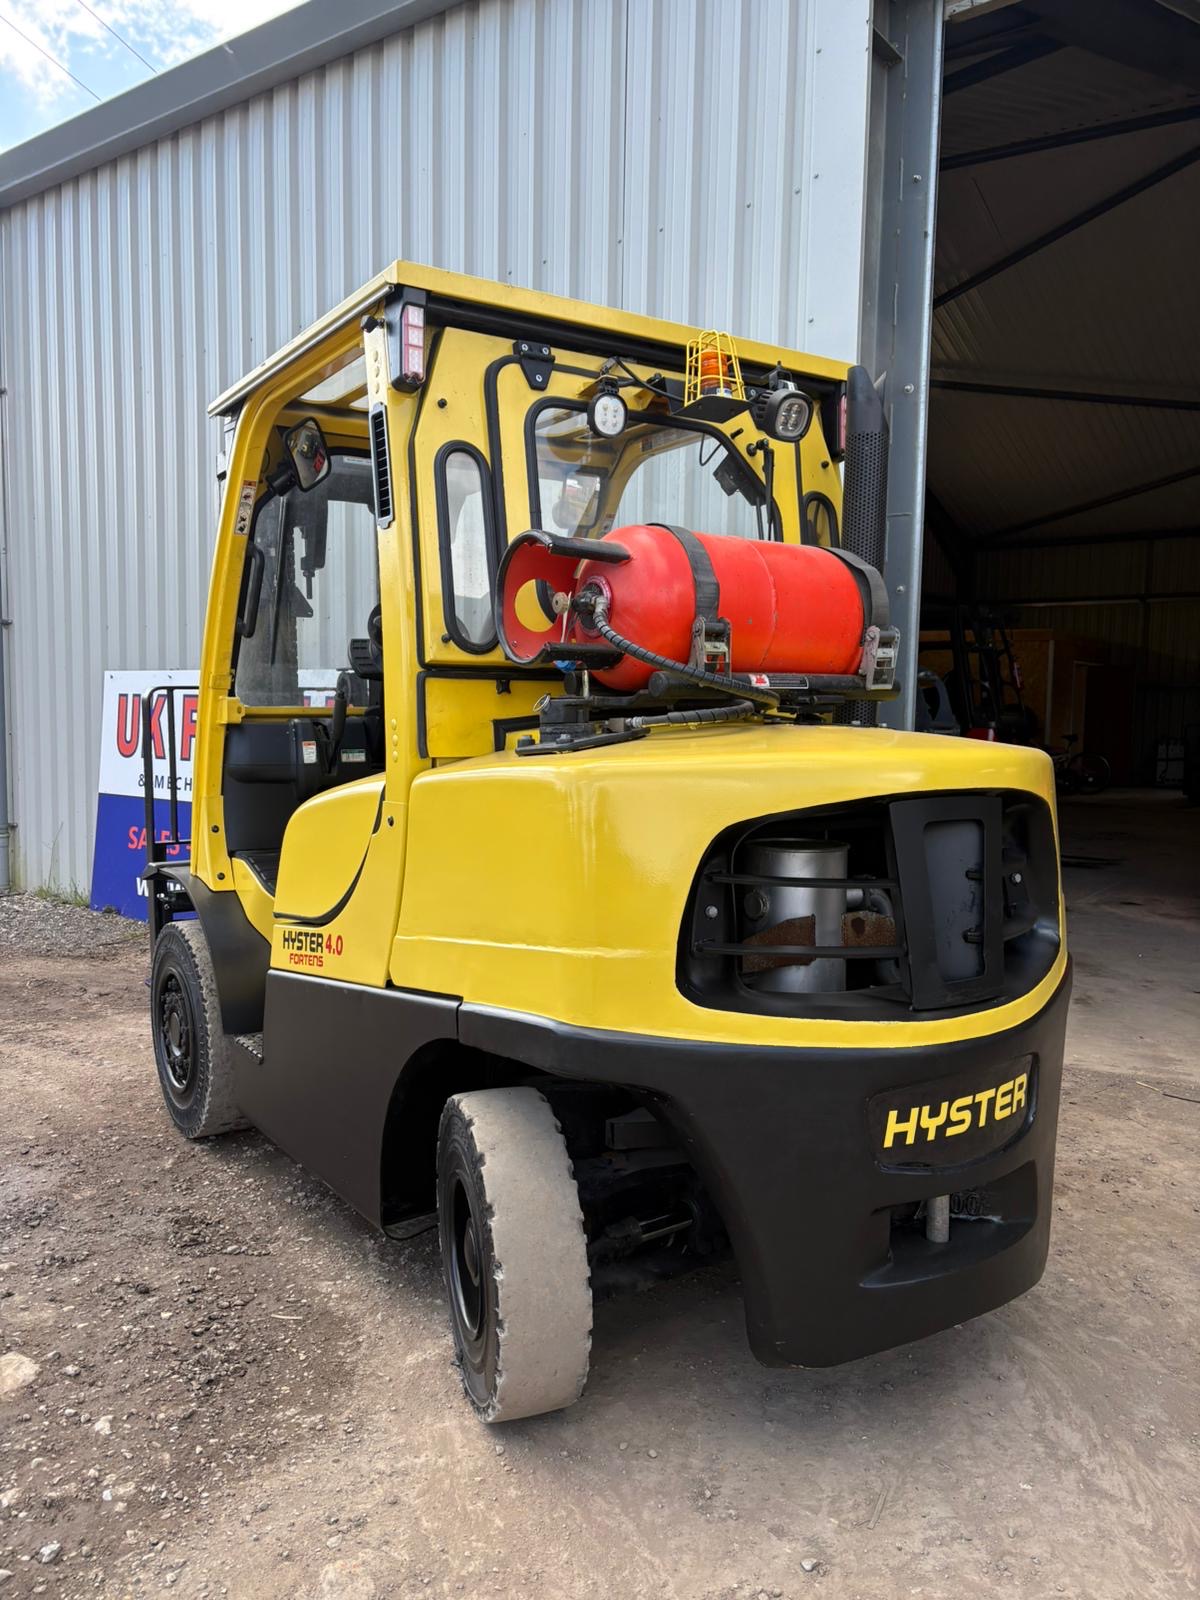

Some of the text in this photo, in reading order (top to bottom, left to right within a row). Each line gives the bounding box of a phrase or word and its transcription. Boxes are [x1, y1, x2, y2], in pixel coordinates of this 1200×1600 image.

[116, 693, 168, 760] UK
[282, 930, 344, 956] HYSTER 4.0
[289, 952, 324, 968] FORTENS
[883, 1073, 1028, 1149] HYSTER
